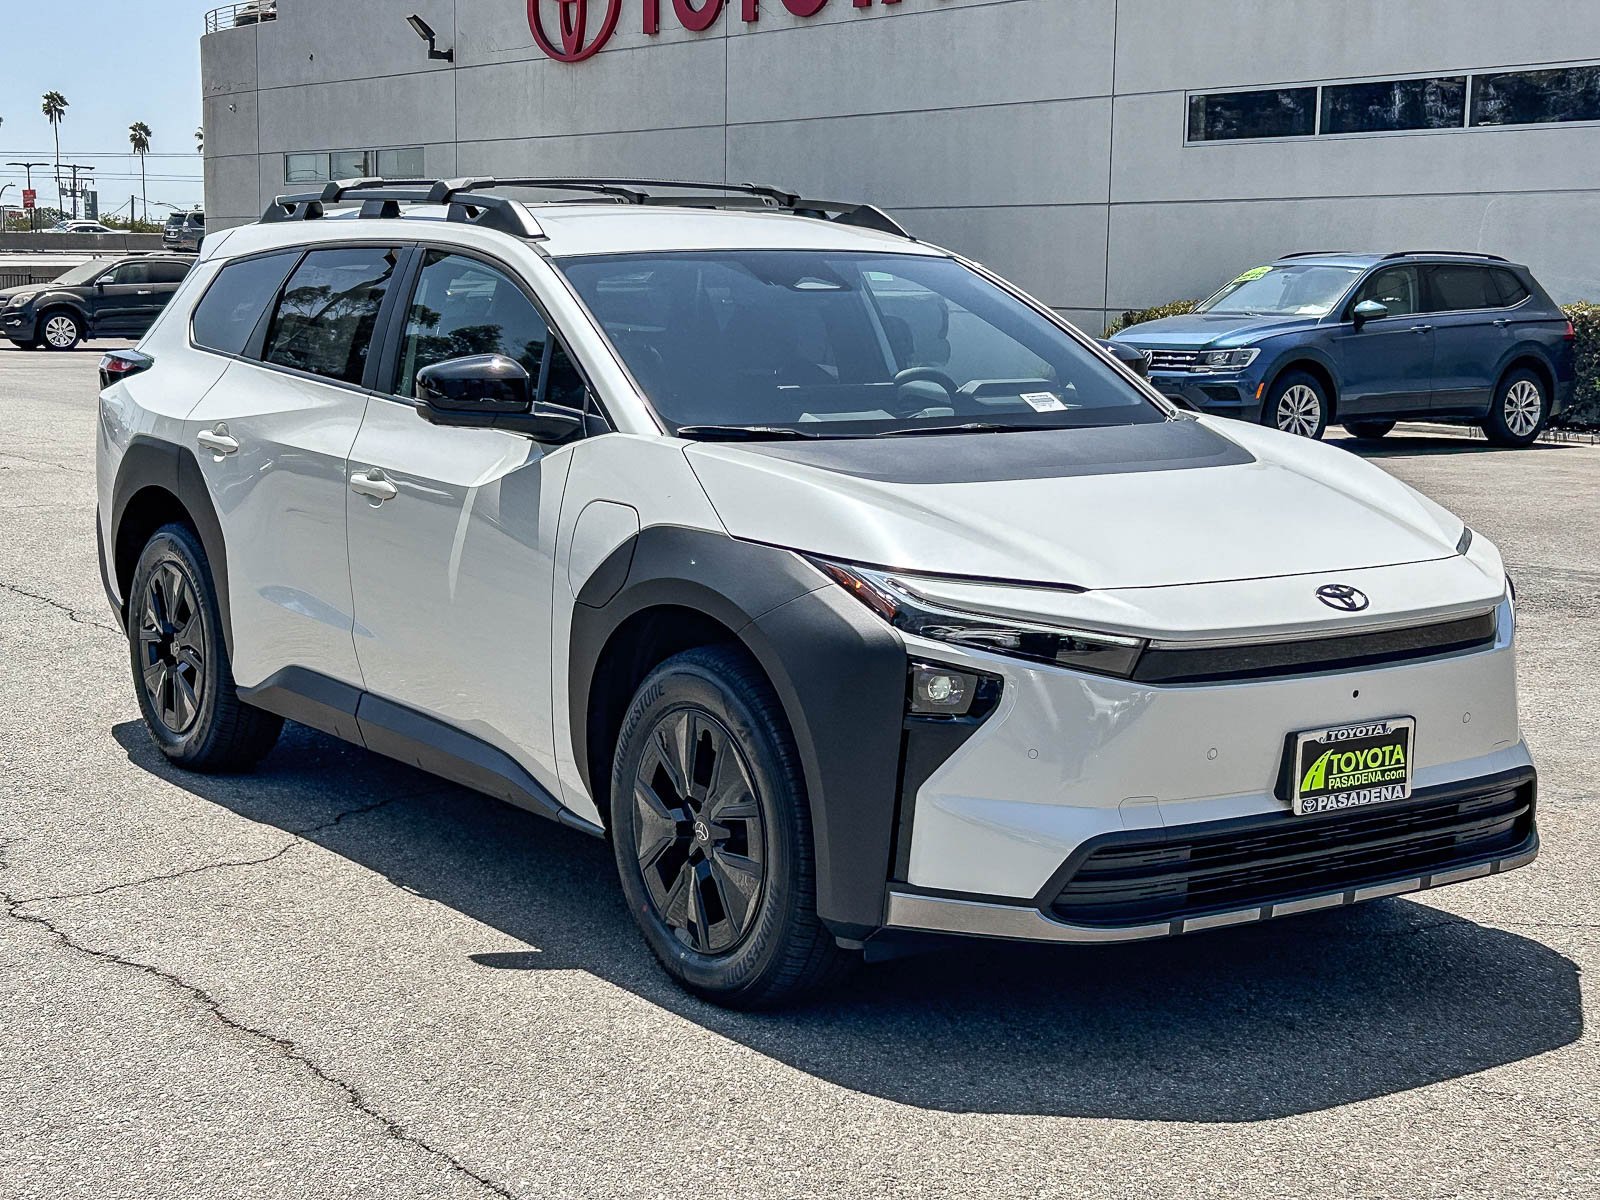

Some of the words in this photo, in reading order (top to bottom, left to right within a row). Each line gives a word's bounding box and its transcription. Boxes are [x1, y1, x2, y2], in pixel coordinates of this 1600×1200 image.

[1329, 725, 1384, 741] TOYOTA
[1331, 745, 1405, 773] TOYOTA
[1329, 770, 1405, 789] PASADENA.com
[1318, 786, 1404, 811] PASADENA
